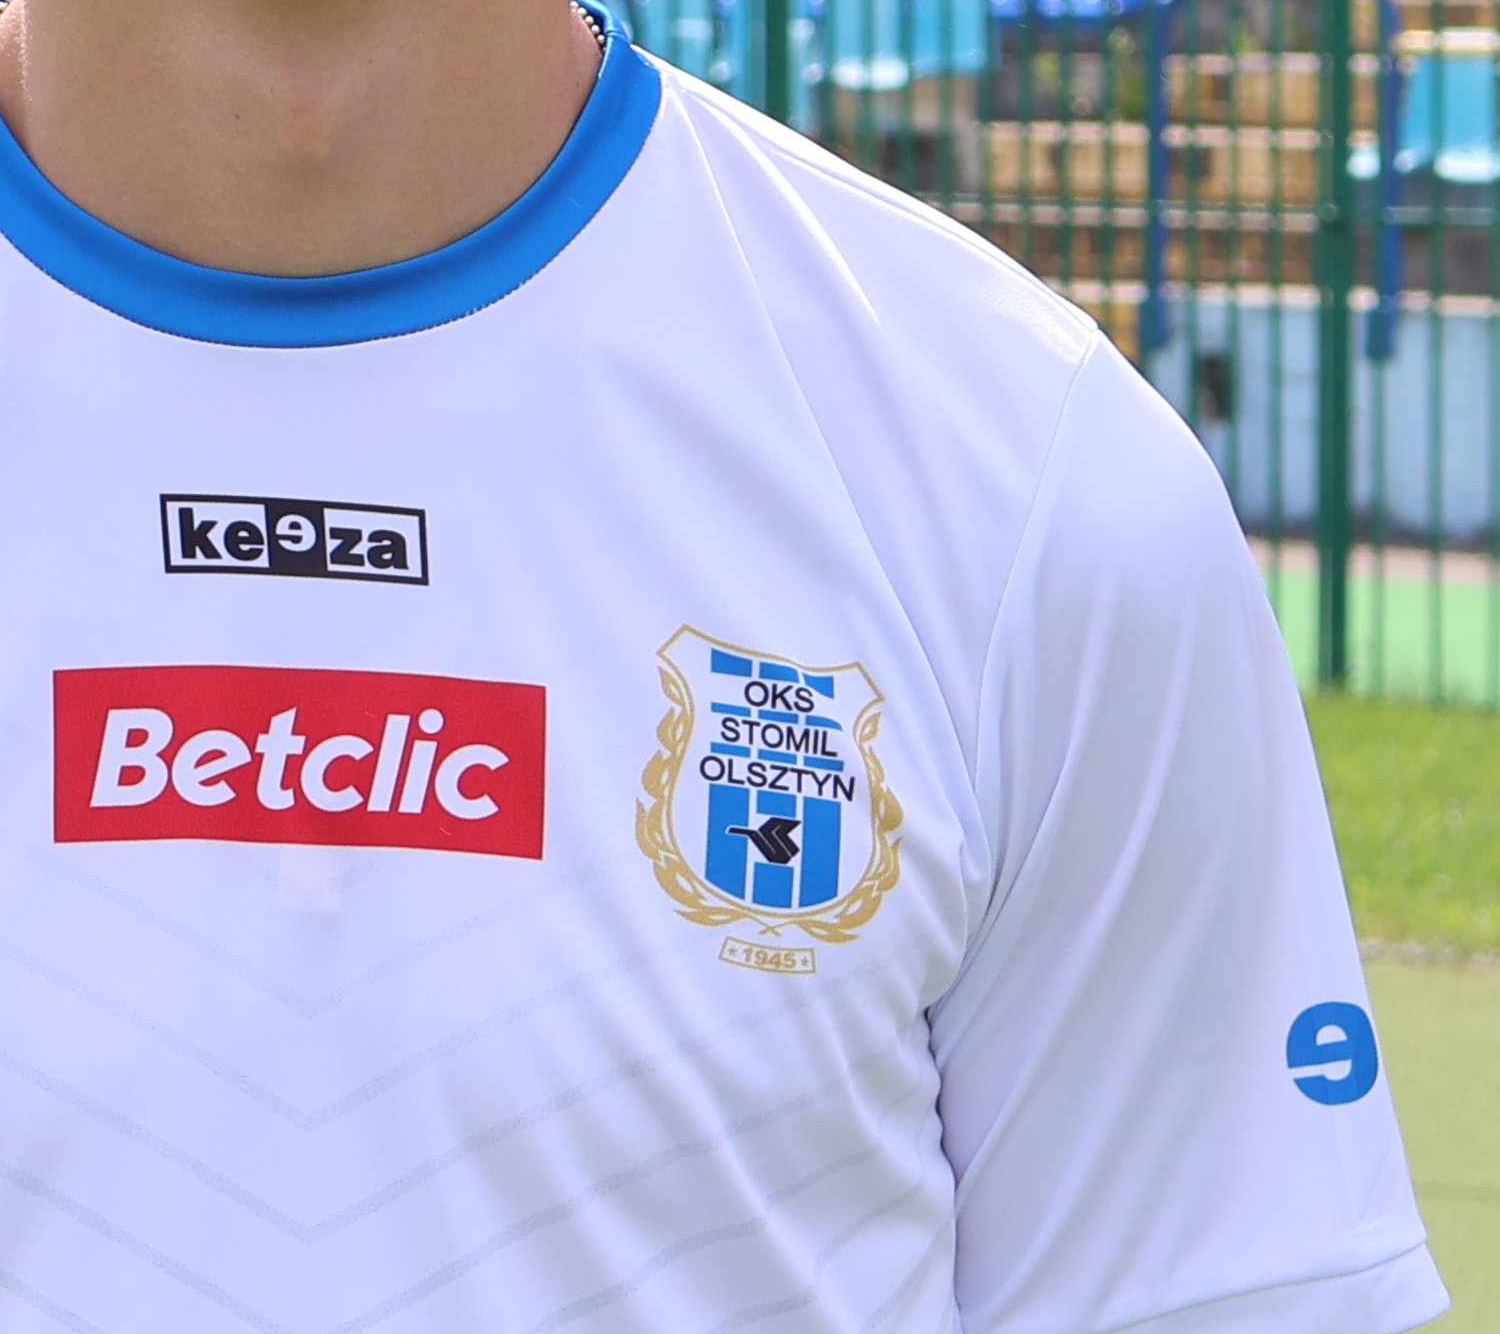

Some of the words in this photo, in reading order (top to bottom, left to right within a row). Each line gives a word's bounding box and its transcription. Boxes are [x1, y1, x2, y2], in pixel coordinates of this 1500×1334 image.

[177, 506, 409, 570] keeza
[743, 680, 815, 714] OKS
[720, 717, 839, 758] STOMIL
[89, 705, 510, 820] Betclic
[699, 755, 856, 803] OLSZTYN
[741, 945, 798, 968] 1945
